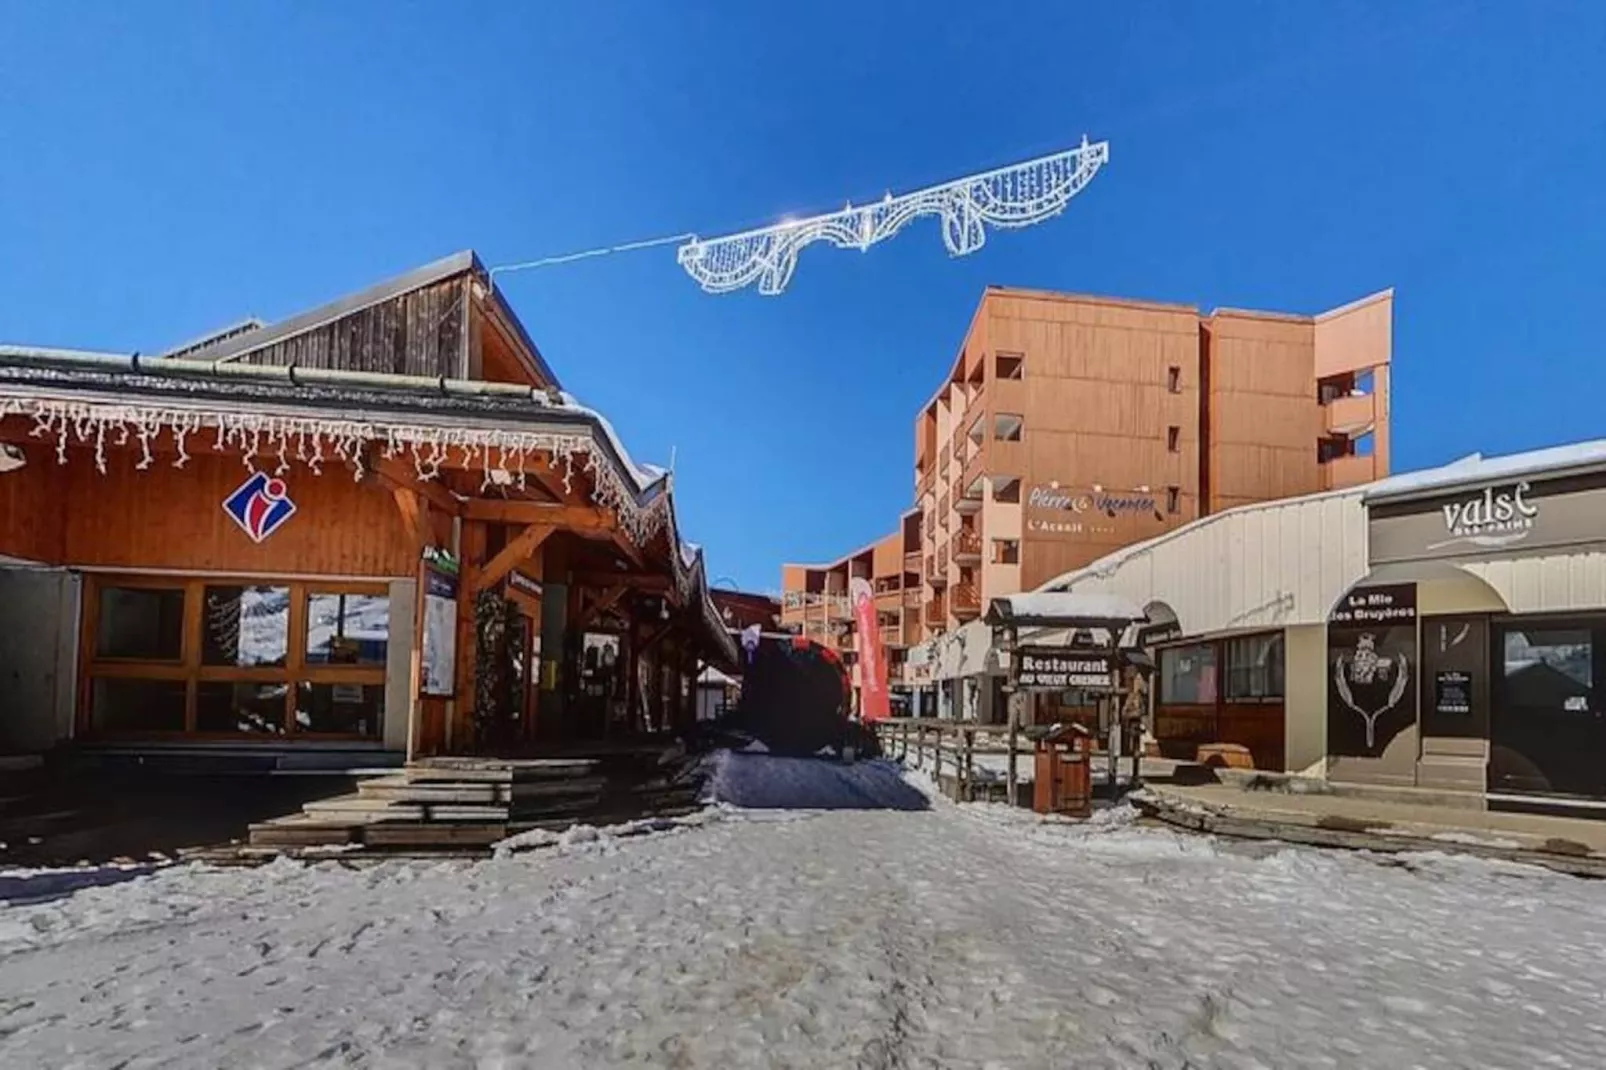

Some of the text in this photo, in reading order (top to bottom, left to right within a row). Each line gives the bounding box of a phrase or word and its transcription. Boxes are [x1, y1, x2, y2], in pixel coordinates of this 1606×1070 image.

[1348, 593, 1393, 607] La Mie
[1022, 655, 1109, 673] Restaurant
